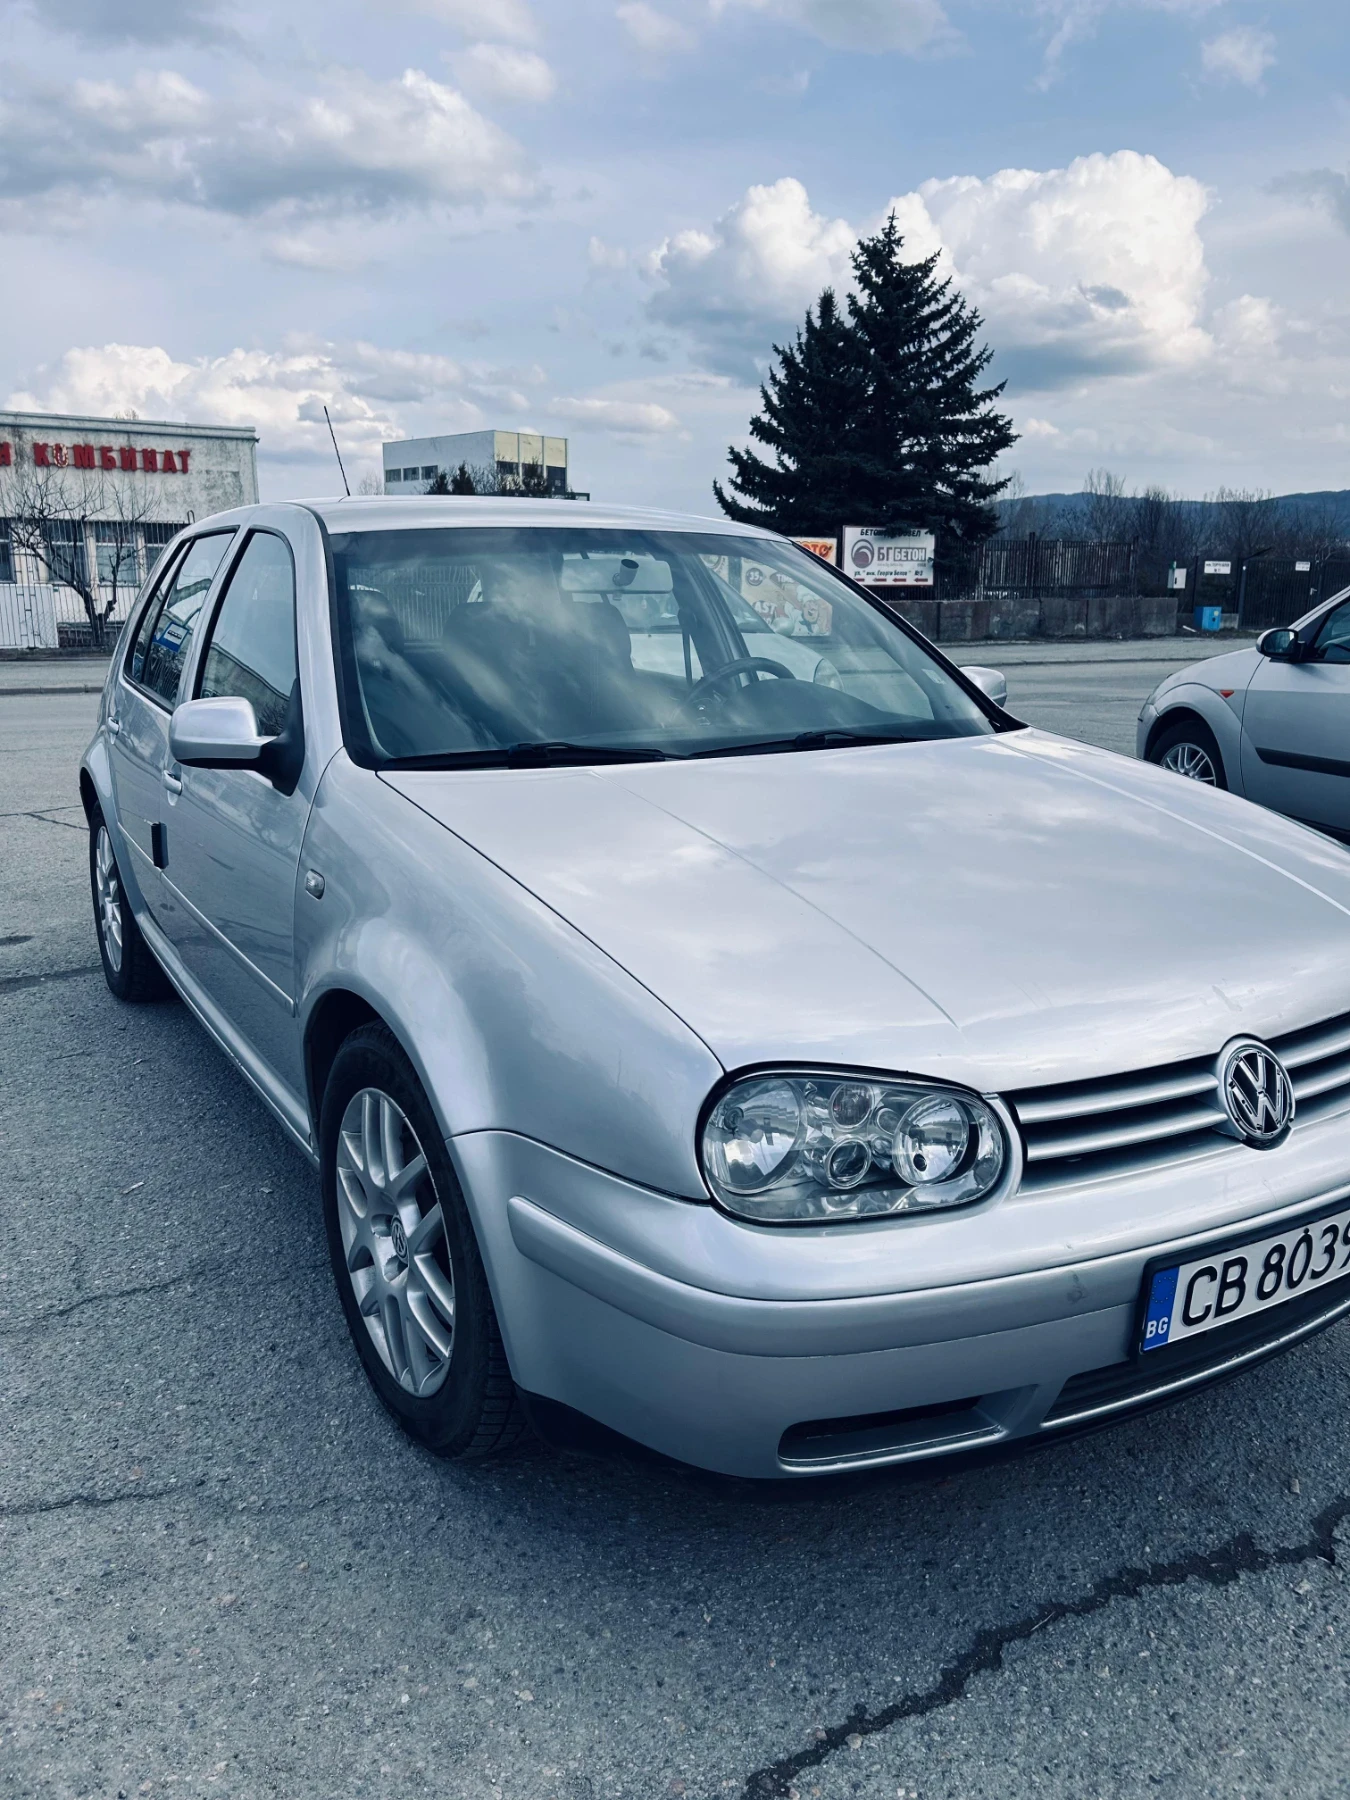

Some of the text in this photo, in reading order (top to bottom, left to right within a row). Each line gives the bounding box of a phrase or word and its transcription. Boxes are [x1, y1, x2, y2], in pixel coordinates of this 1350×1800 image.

[33, 442, 191, 474] КОМБИНАТ
[1181, 1255, 1249, 1327] CB
[1145, 1316, 1169, 1339] BG
